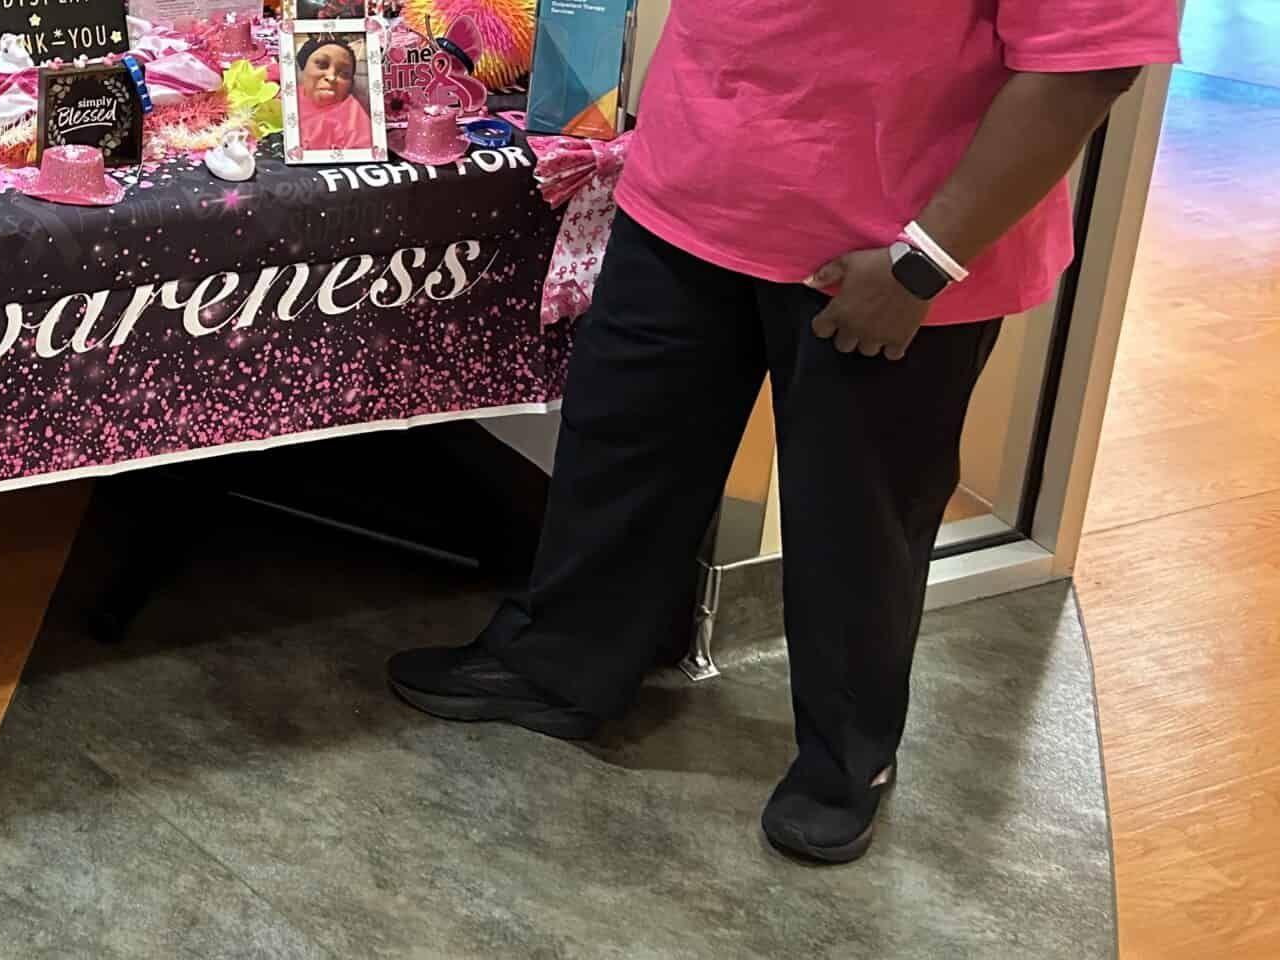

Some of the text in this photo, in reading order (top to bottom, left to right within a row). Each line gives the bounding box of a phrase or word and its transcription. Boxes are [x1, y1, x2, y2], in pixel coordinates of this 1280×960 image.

[68, 25, 108, 50] YOU
[57, 99, 118, 127] Blessed
[77, 96, 113, 108] simply
[456, 146, 532, 176] FOR
